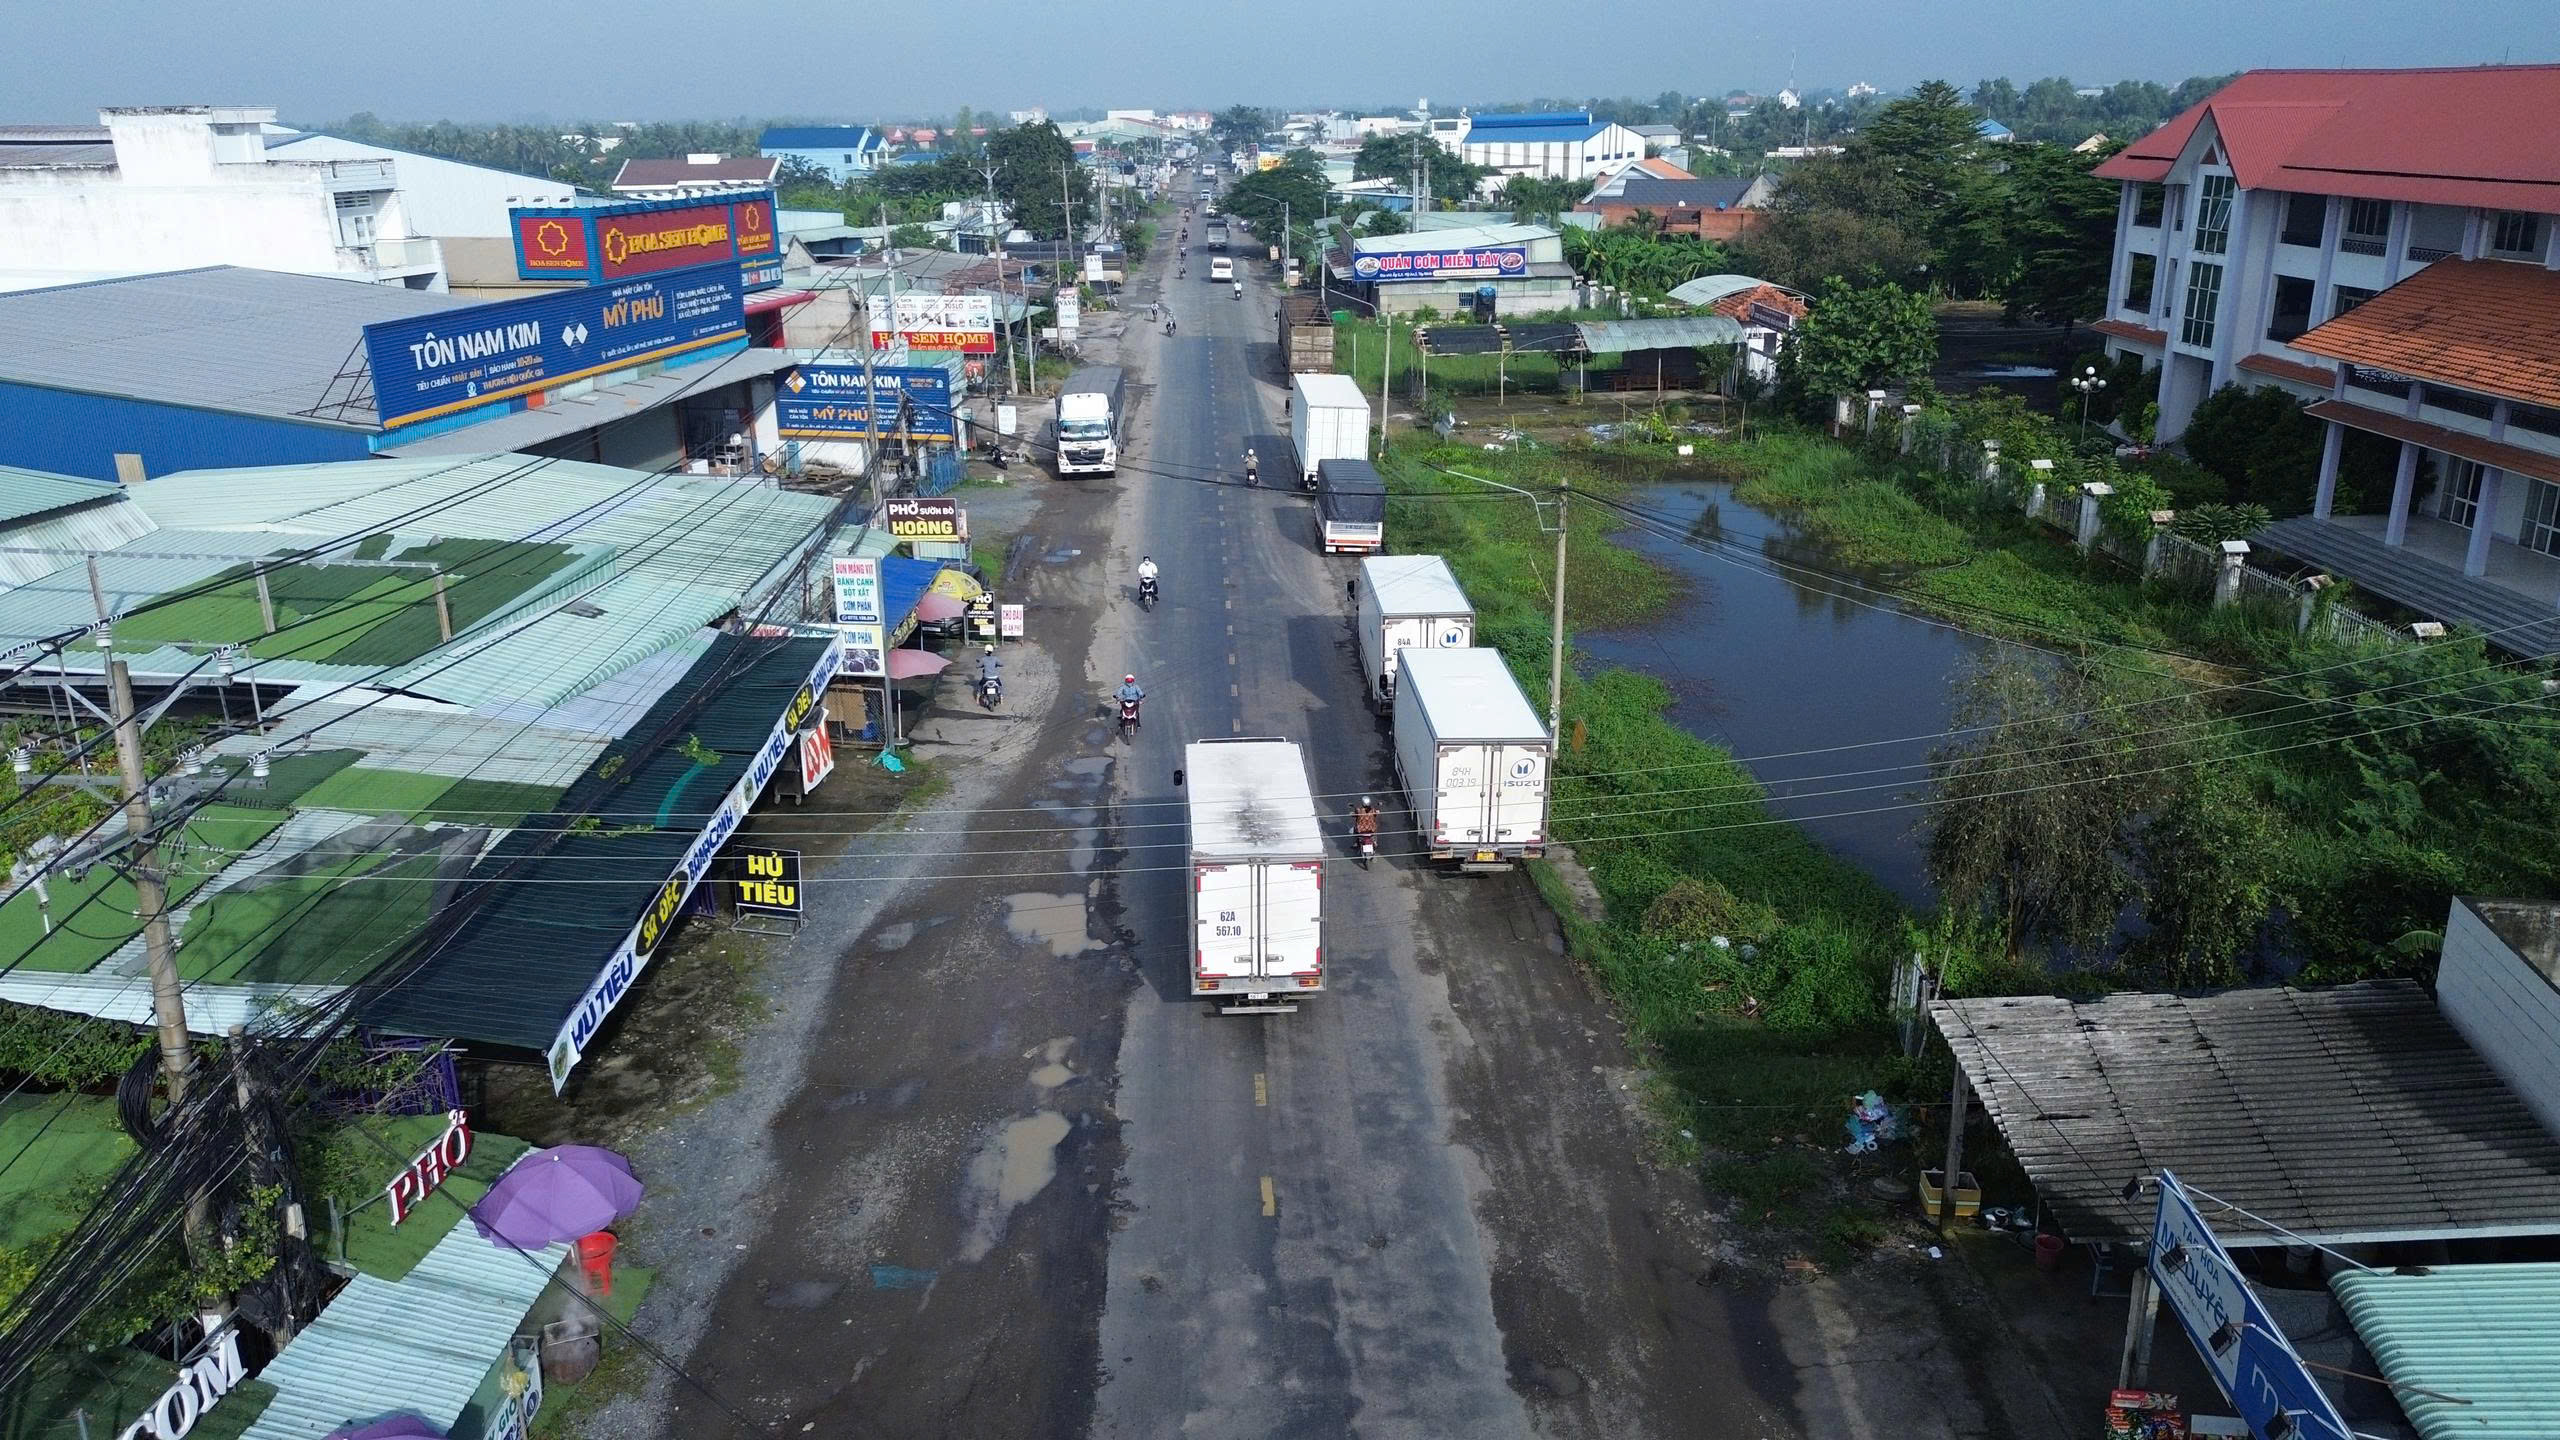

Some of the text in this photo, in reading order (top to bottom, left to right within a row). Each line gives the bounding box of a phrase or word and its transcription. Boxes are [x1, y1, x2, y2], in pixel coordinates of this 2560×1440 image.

[687, 223, 728, 246] HOME
[560, 259, 584, 268] HOME
[1380, 250, 1500, 271] QUÁN CƠM MIỀN TÂY
[603, 290, 664, 330] MỸ PHÚ
[410, 320, 541, 371] TÔN NAM KIM
[912, 333, 939, 344] SEN
[943, 332, 989, 345] HOME
[810, 371, 838, 387] TÔN
[875, 375, 901, 388] KIM
[813, 405, 834, 420] MỸ
[838, 406, 869, 421] PHÚ
[889, 500, 954, 516] PHỞ SƯỜN BÒ
[892, 516, 953, 535] HOÀNG
[1397, 637, 1411, 646] 84A
[747, 851, 784, 877] HỦ
[738, 877, 795, 906] TIẾU
[1220, 911, 1236, 922] 62A
[643, 913, 659, 949] SA
[1216, 925, 1241, 936] 567.10
[571, 951, 633, 1054] HỦ TIẾU
[386, 1108, 472, 1227] PHỞ
